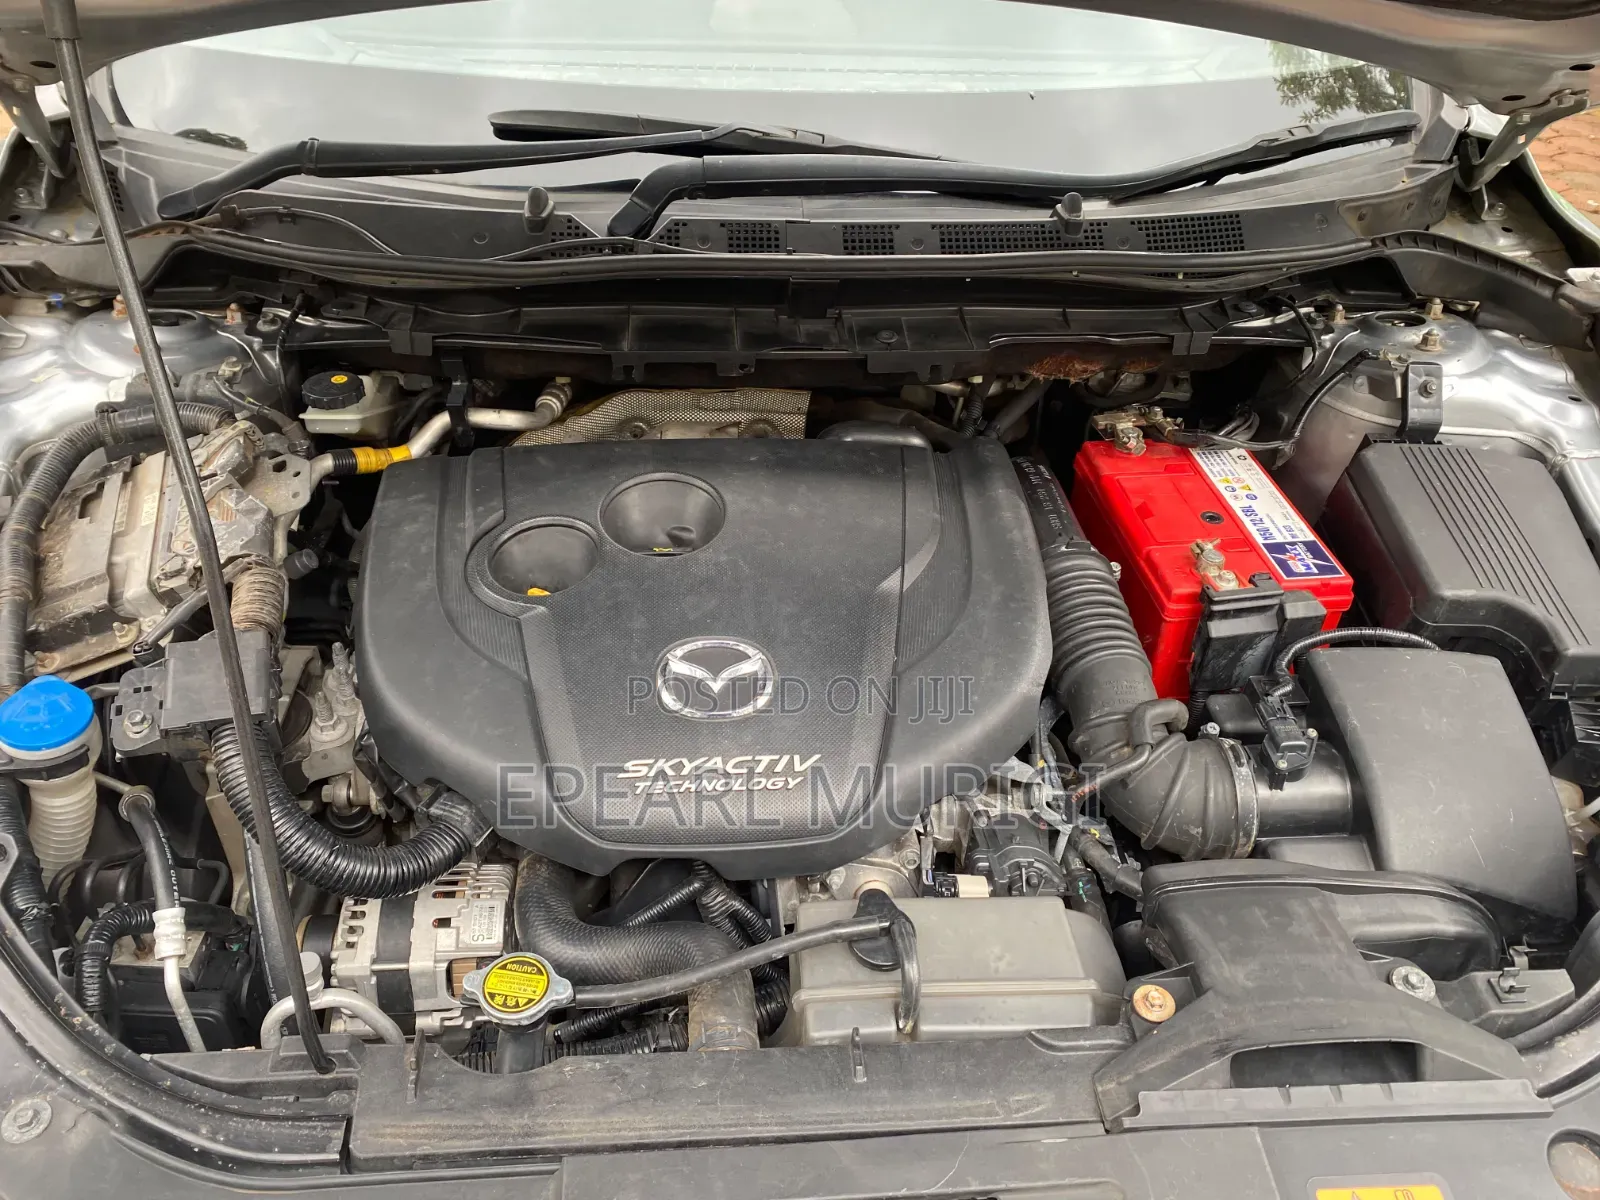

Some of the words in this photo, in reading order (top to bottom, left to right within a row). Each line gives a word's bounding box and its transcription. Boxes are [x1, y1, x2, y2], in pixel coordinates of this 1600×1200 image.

[616, 754, 822, 779] SKYACTIV
[634, 776, 804, 795] TECHNOLOGY
[506, 963, 537, 974] CAUTION
